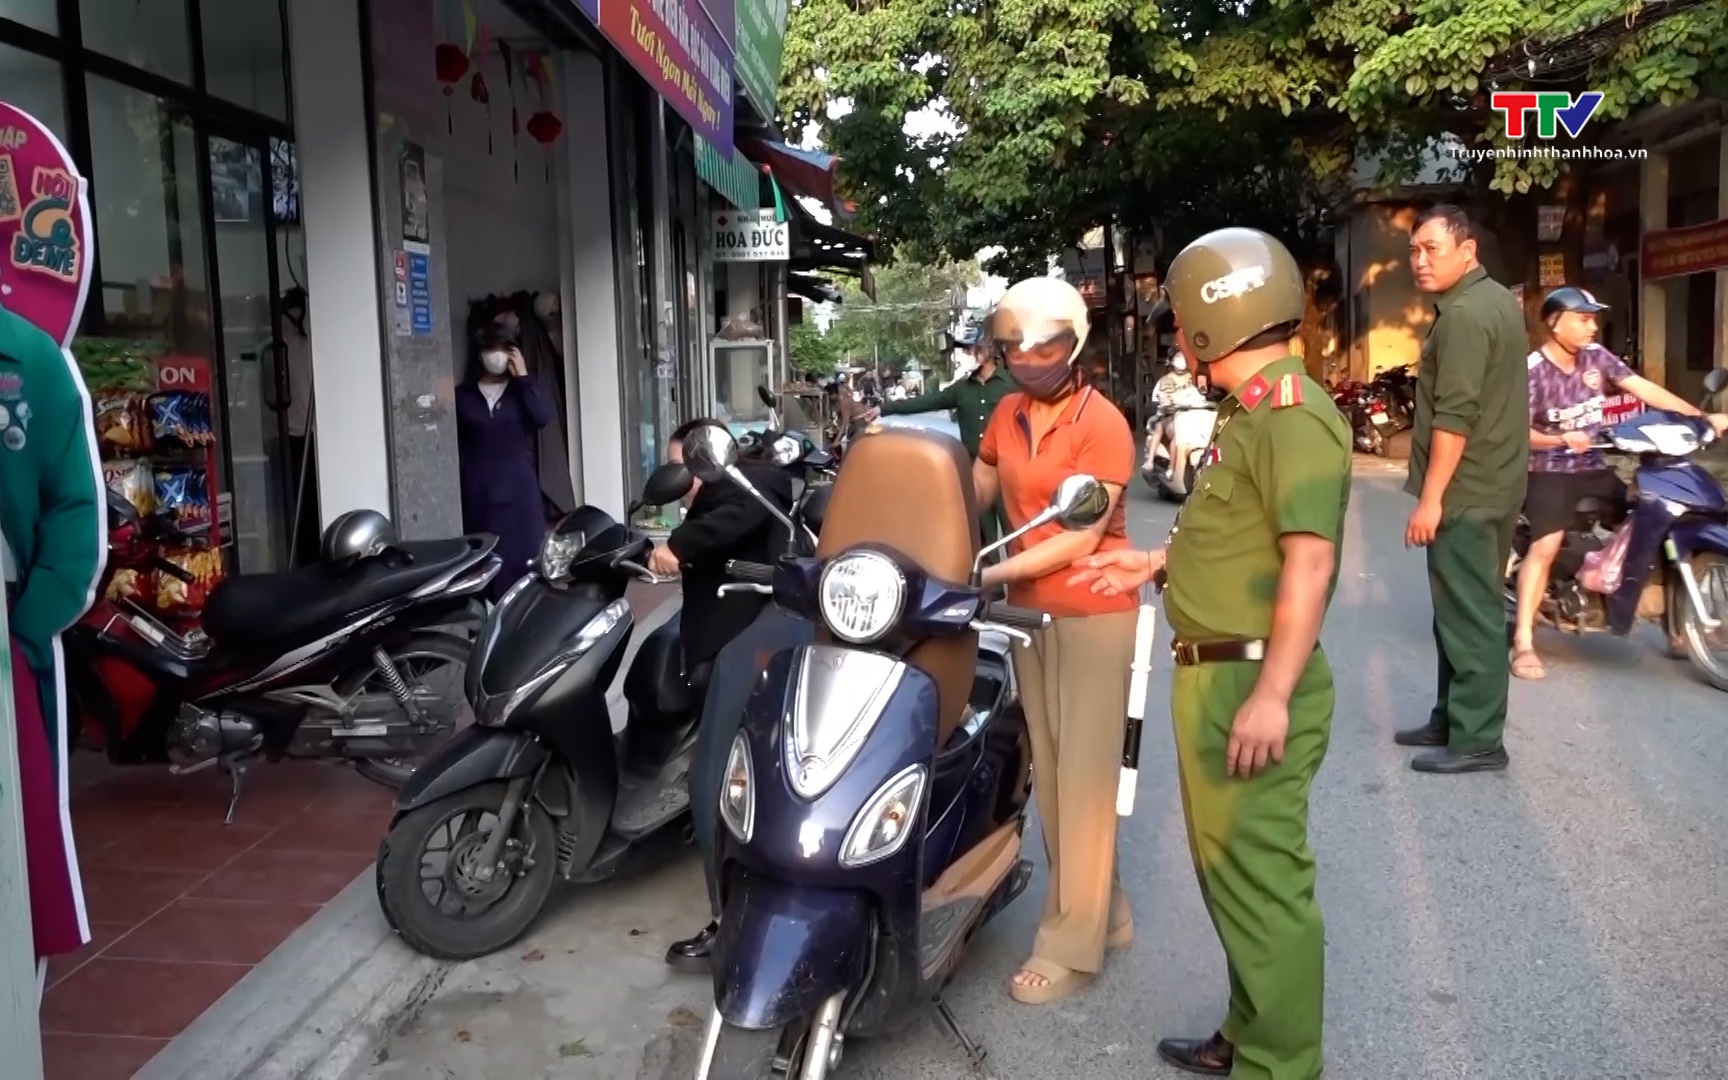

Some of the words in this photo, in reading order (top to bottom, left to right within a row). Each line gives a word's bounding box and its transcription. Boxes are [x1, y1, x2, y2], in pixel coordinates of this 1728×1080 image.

[656, 38, 681, 87] Ngon
[716, 231, 748, 248] HOA
[752, 225, 784, 248] ĐỨC
